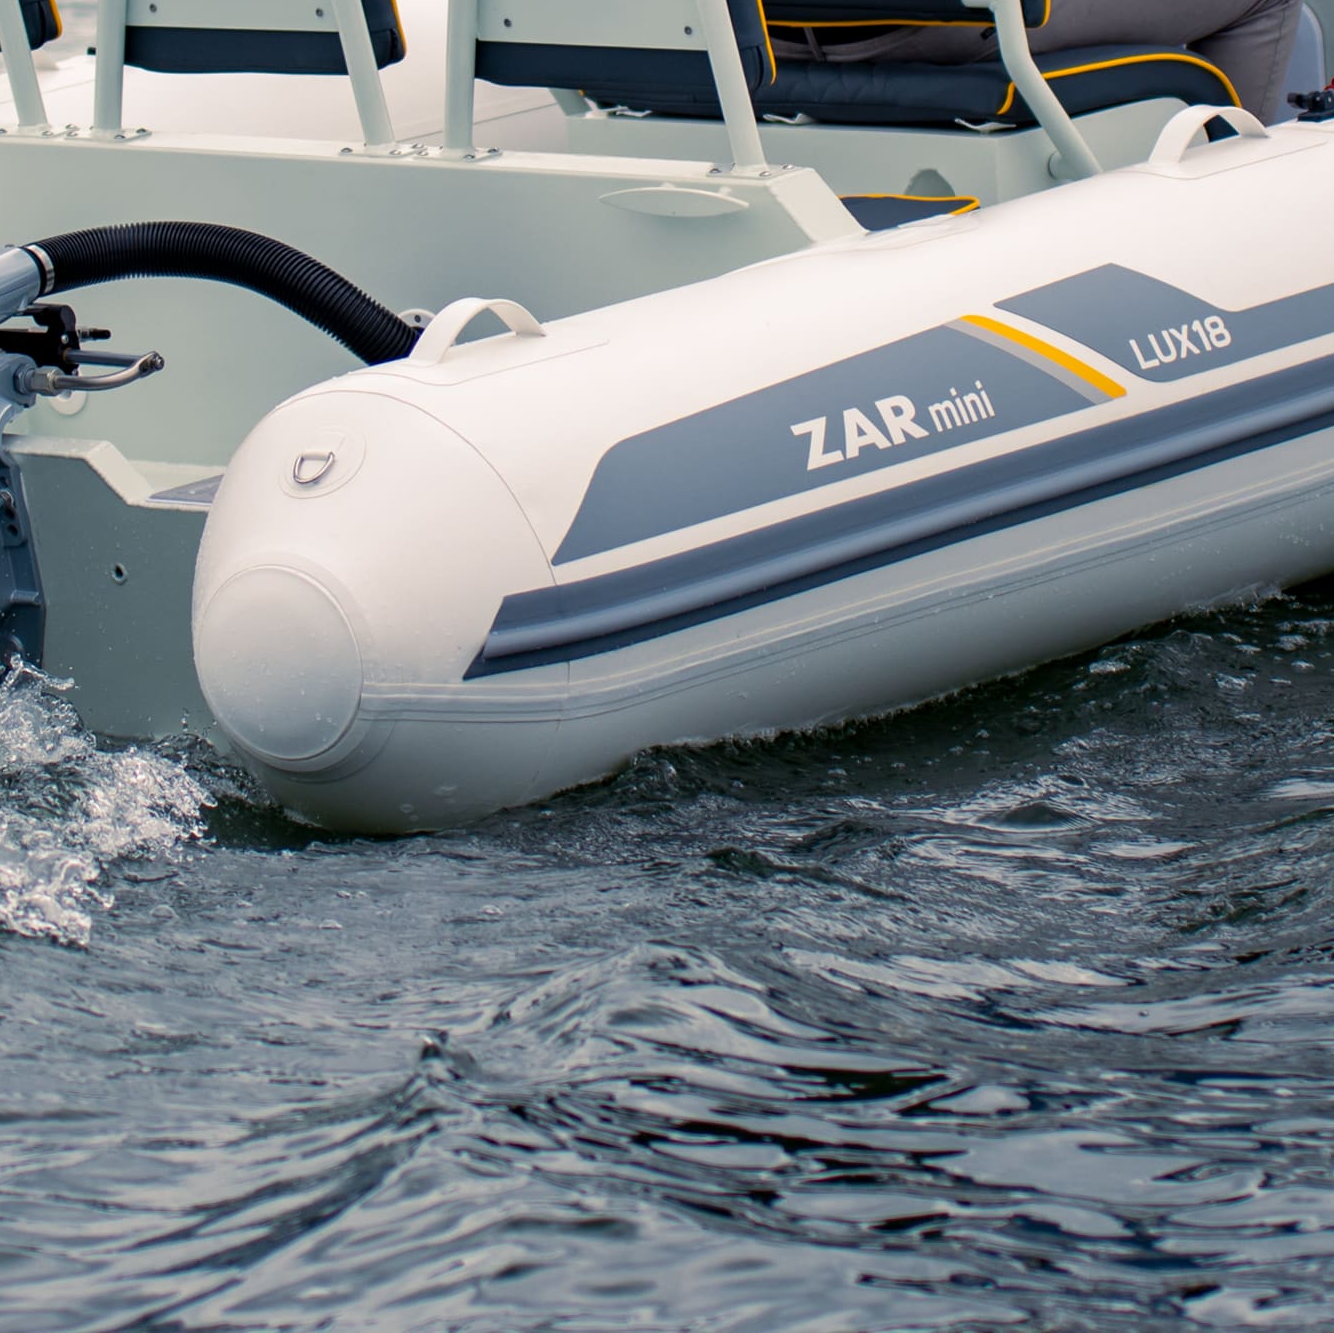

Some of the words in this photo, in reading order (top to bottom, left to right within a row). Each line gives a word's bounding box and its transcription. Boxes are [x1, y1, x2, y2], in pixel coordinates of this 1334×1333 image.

[1128, 315, 1232, 370] LUX18
[790, 394, 929, 471] ZAR
[927, 380, 996, 433] mini
